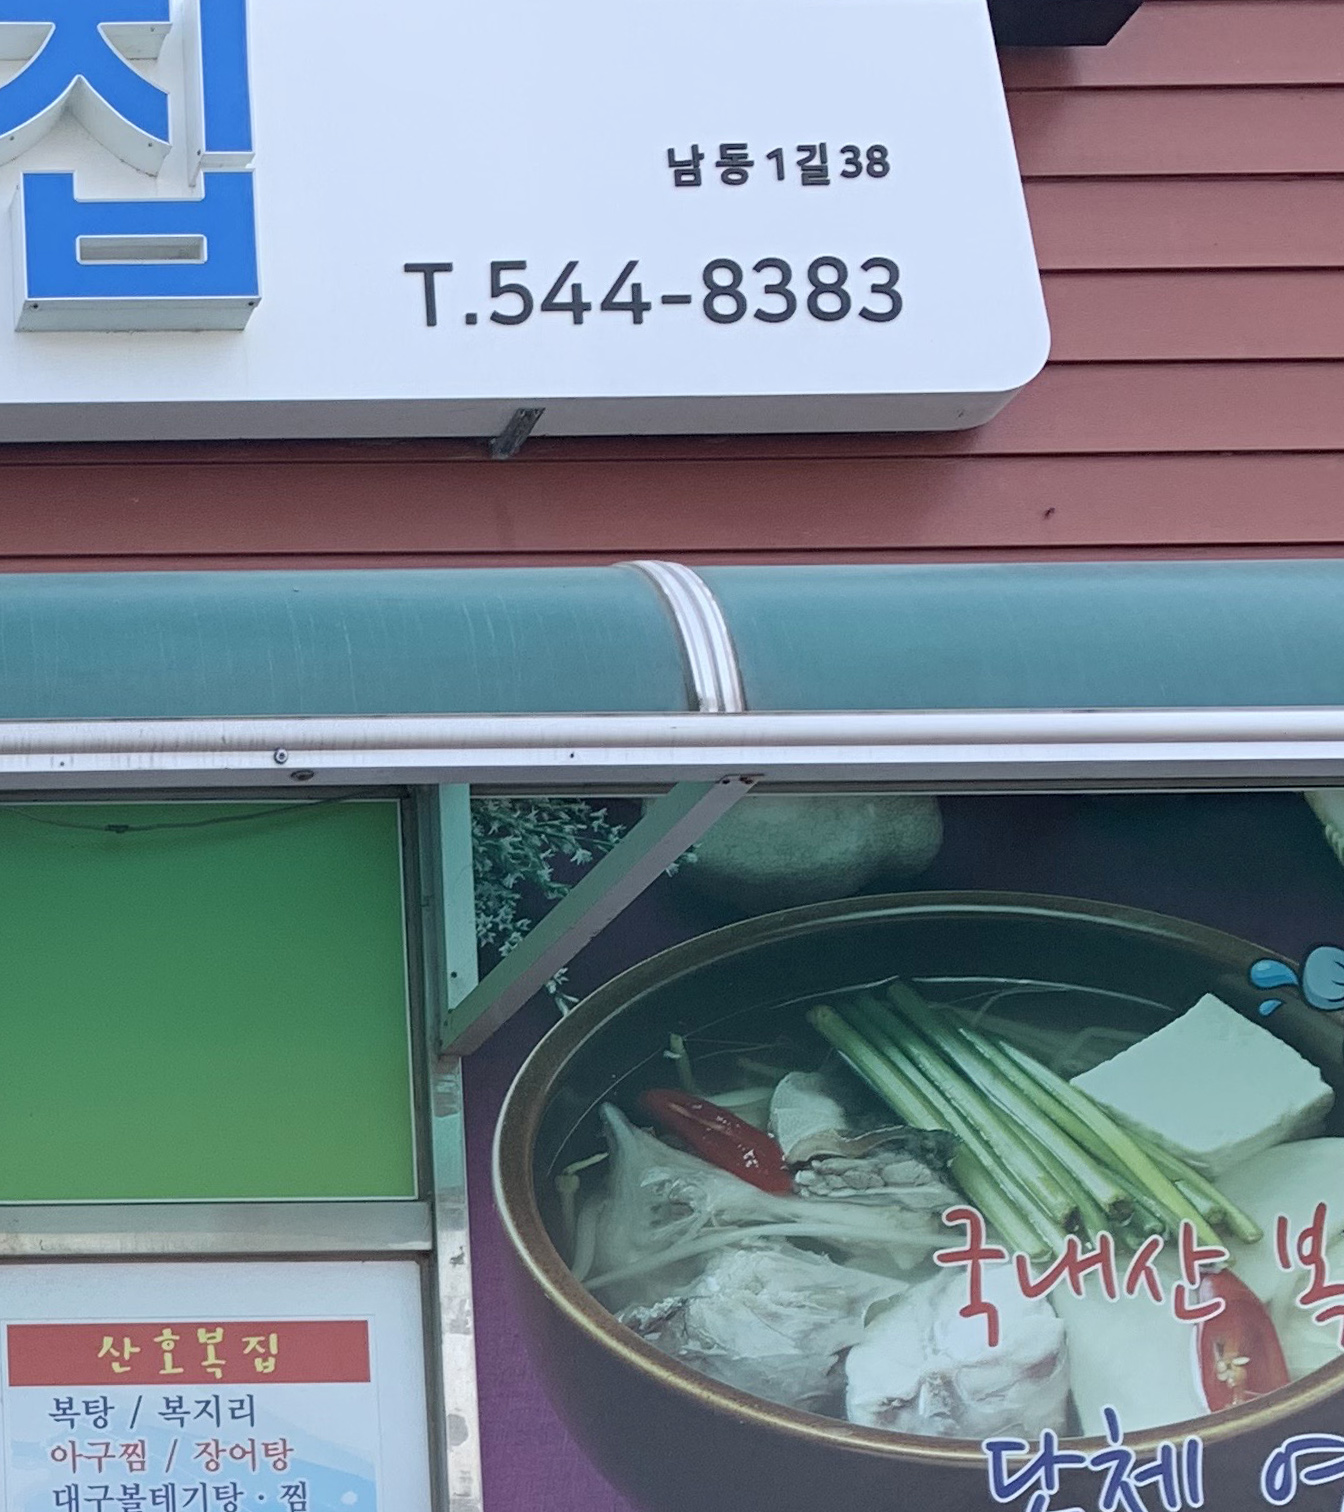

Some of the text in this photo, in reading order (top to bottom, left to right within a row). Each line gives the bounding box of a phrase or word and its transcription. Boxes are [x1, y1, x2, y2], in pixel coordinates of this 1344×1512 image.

[403, 256, 904, 328] T.544-8383
[935, 1205, 1229, 1349] 국내산
[98, 1327, 280, 1379] 산호복집
[48, 1395, 114, 1430] 복탕
[158, 1394, 257, 1428] 복지리
[50, 1438, 148, 1473] 아구찜
[193, 1437, 295, 1472] 장어탕
